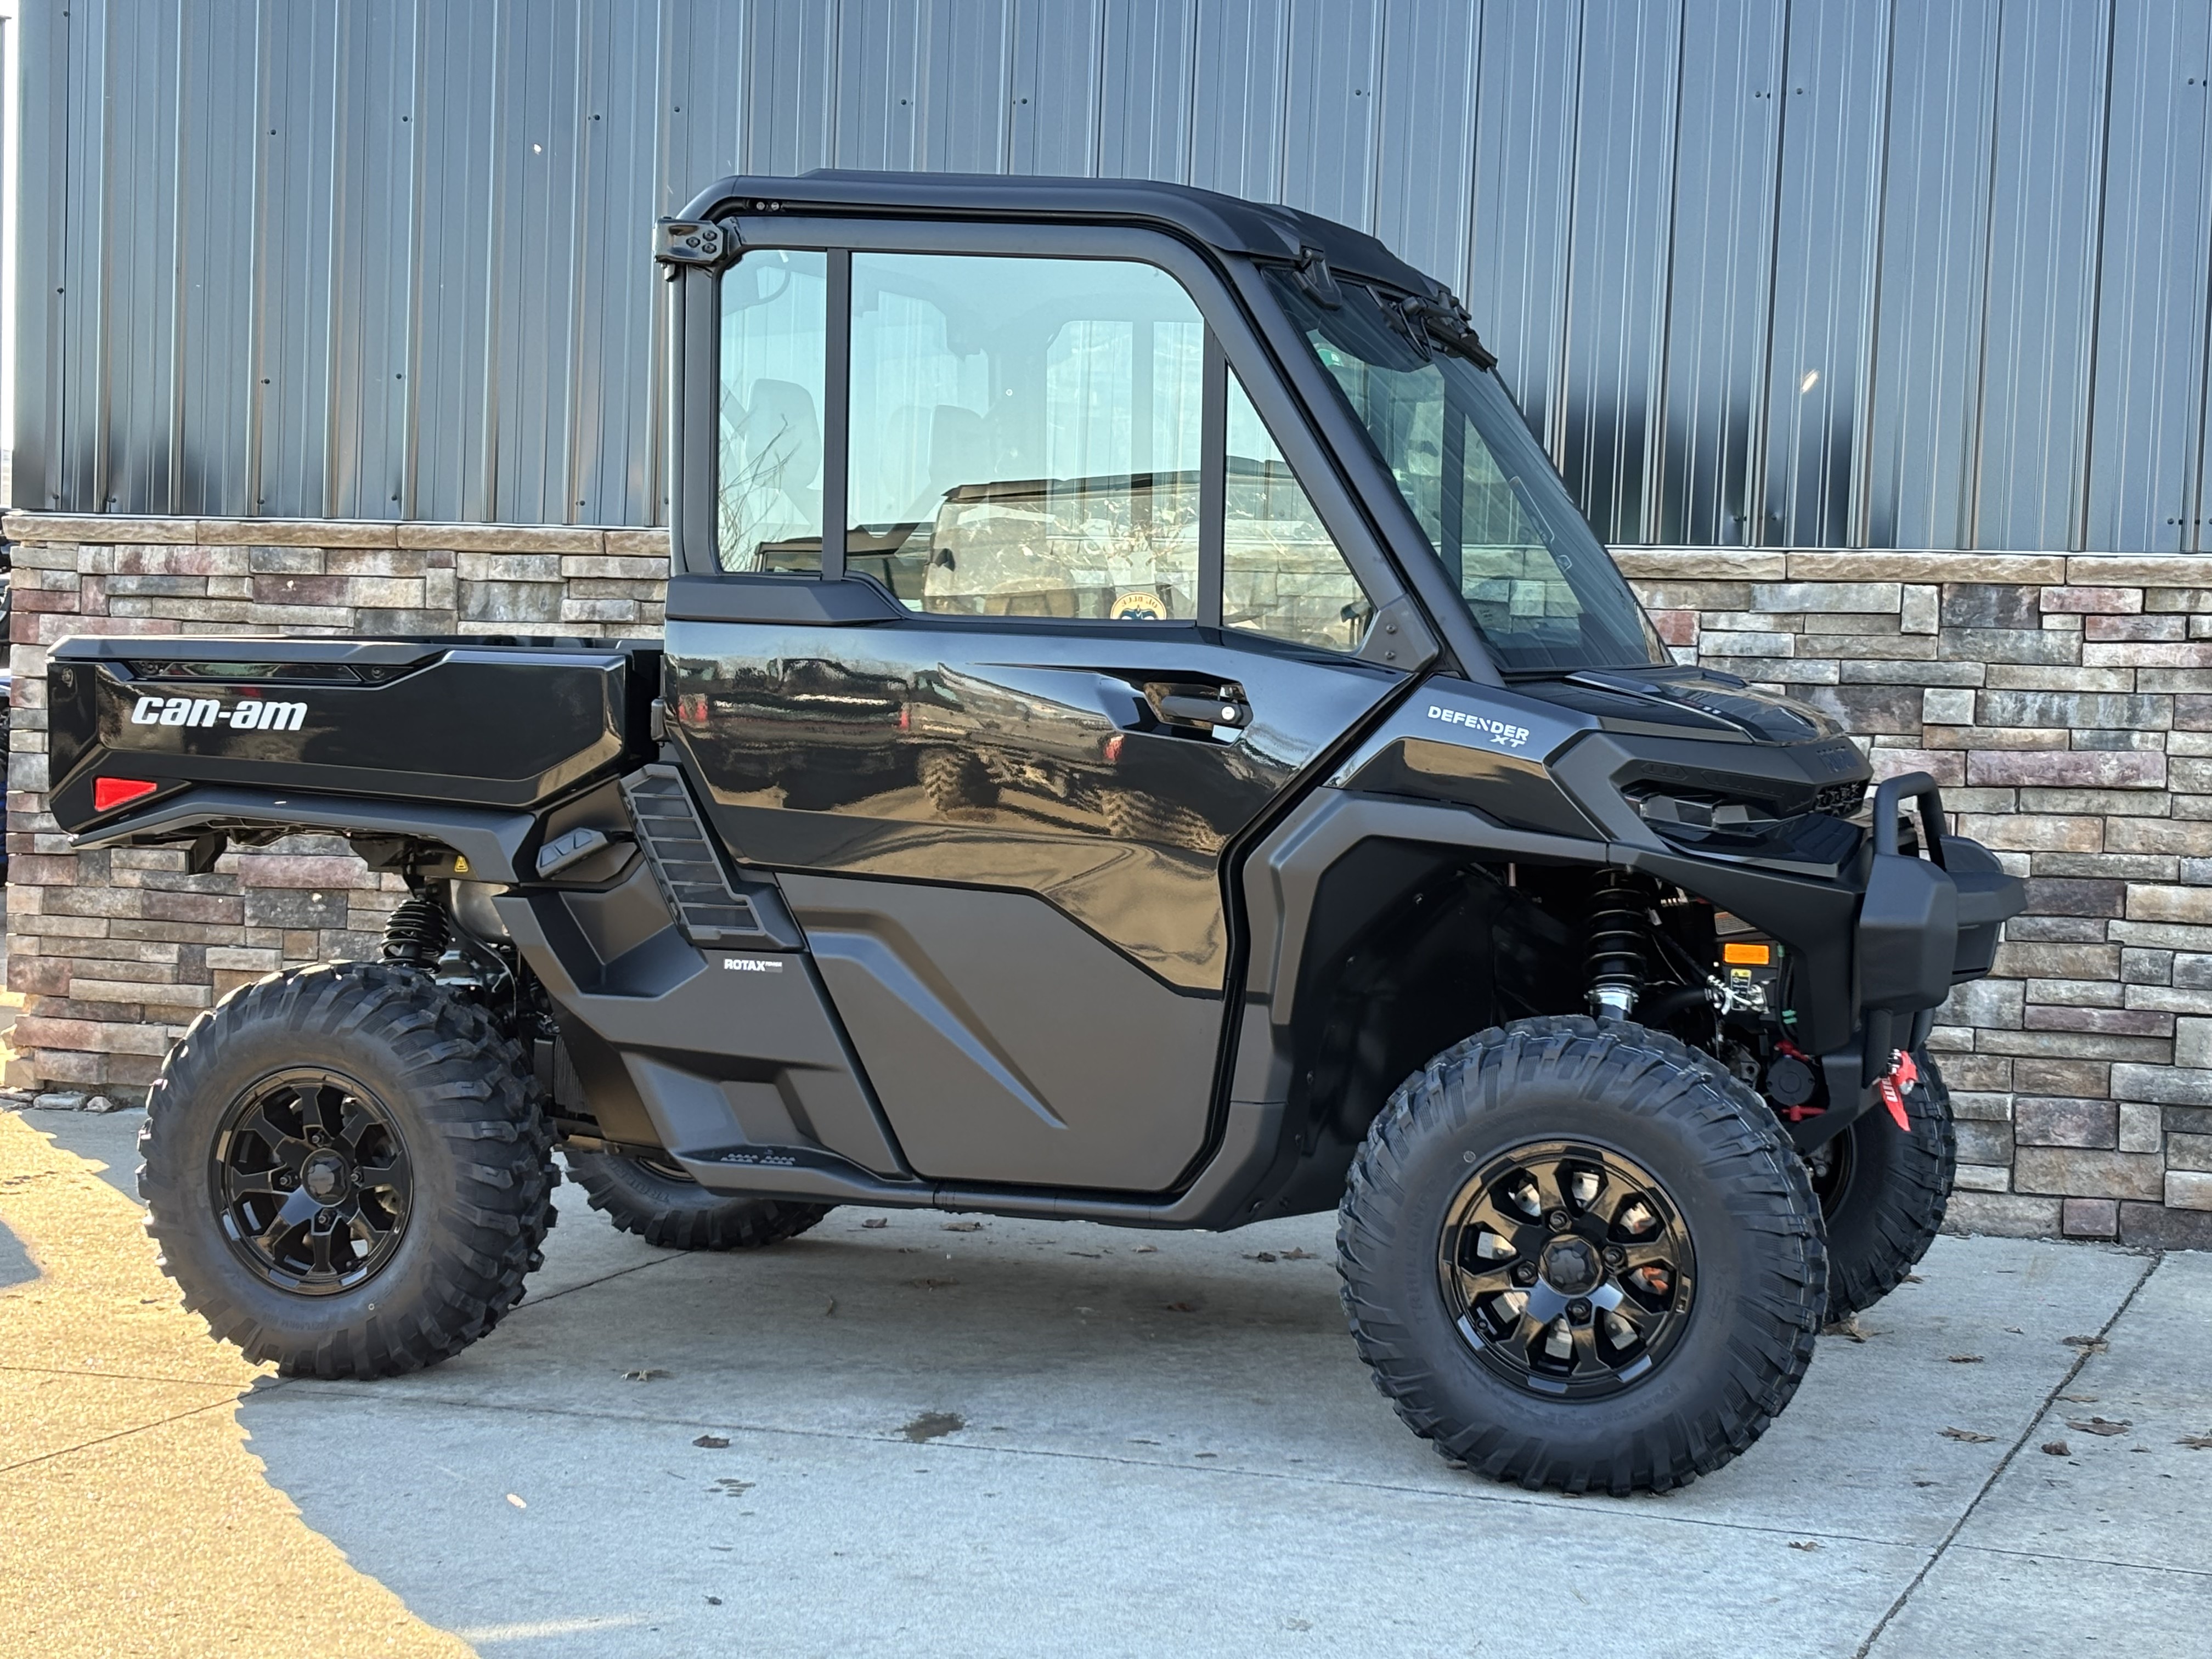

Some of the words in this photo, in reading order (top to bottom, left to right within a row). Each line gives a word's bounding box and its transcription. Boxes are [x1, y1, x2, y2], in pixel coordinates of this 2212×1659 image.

[131, 697, 308, 730] can-am
[1427, 706, 1530, 741] DEFENDER
[1489, 734, 1525, 748] XT
[724, 958, 765, 972] ROTAX
